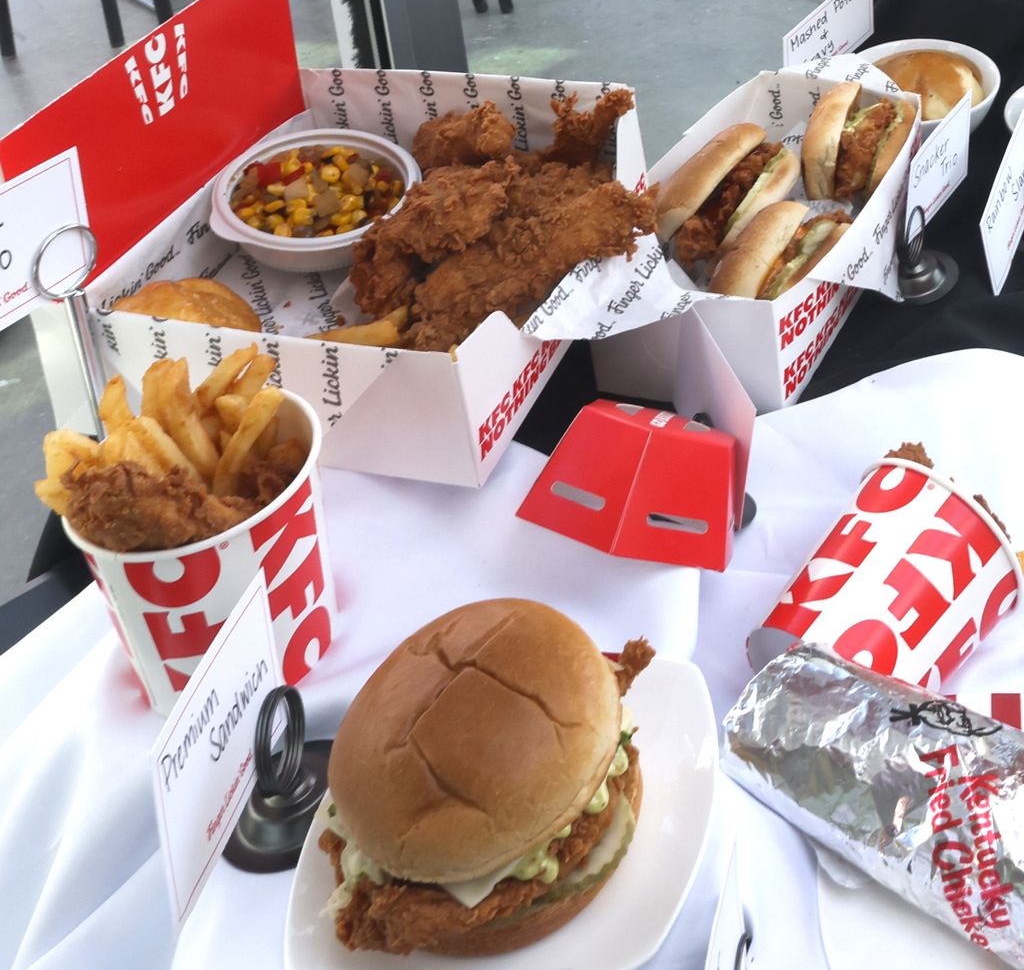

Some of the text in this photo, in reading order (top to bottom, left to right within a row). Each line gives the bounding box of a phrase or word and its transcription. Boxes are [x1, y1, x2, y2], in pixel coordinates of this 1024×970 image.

[790, 11, 828, 52] Mashed
[144, 33, 175, 117] KFC
[328, 69, 345, 97] Goo
[374, 69, 391, 97] Goo
[419, 70, 435, 97] Goo
[768, 87, 783, 120] Good
[913, 138, 950, 189] Snacker
[940, 152, 958, 176] Trio
[985, 166, 1012, 234] Rainbow
[847, 246, 870, 281] Good
[607, 280, 645, 316] Finger
[779, 293, 814, 335] KFC
[780, 283, 840, 351] NOTHIN
[321, 342, 342, 406] Lickin'
[783, 340, 814, 386] KFC
[479, 391, 511, 445] KFC
[513, 349, 540, 399] KFC
[480, 352, 548, 462] NOTHING
[250, 478, 331, 687] KFC
[762, 464, 930, 639] KFC
[832, 492, 1003, 676] KFC
[161, 688, 220, 792] Premium
[210, 659, 269, 761] Sandwich
[920, 744, 989, 951] Fried Chicke
[959, 774, 1013, 929] Kentucky
